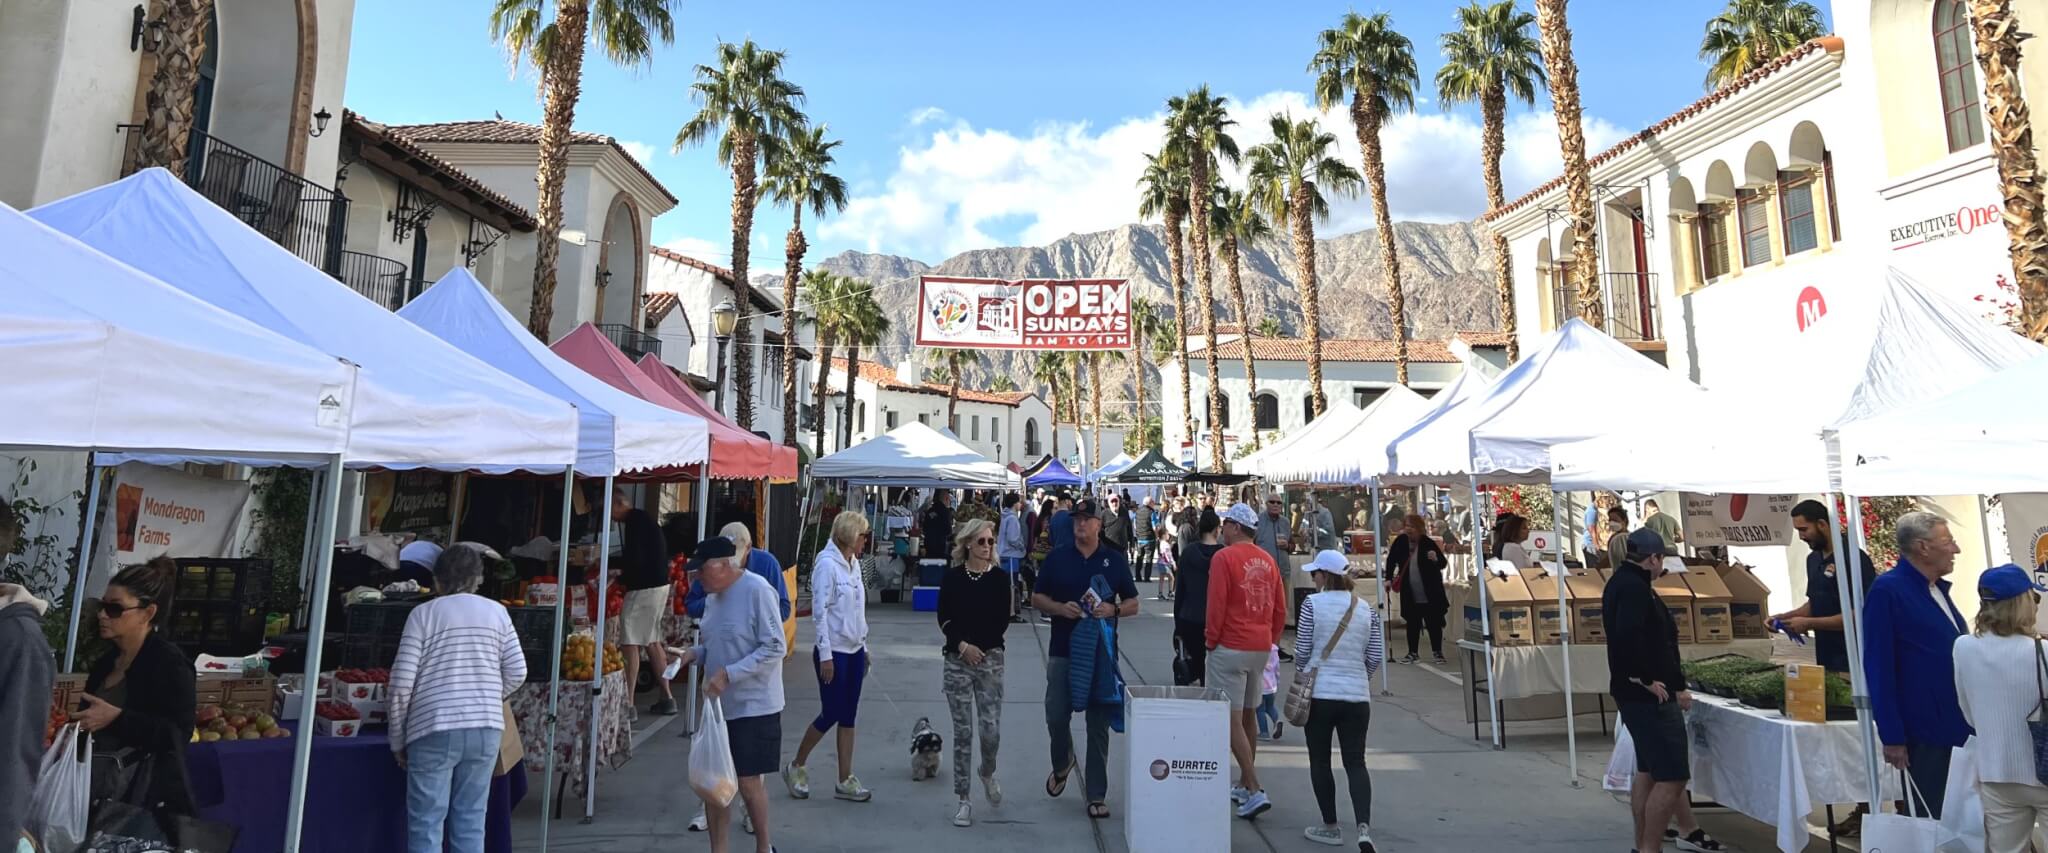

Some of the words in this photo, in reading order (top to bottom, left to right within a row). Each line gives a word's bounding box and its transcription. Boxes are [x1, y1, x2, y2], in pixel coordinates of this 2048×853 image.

[1889, 212, 1957, 242] EXECUTIVE
[1957, 203, 2000, 235] One
[1025, 284, 1127, 316] OPEN
[1025, 316, 1127, 332] SUNDAYS
[1025, 335, 1057, 345] 8AM
[1068, 335, 1085, 345] TO
[1097, 335, 1127, 345] 1PM
[144, 496, 205, 524] Mondragon
[138, 525, 171, 546] Farms
[1741, 525, 1772, 542] FARM
[1103, 558, 1110, 567] S
[1171, 760, 1218, 770] BURRTEC
